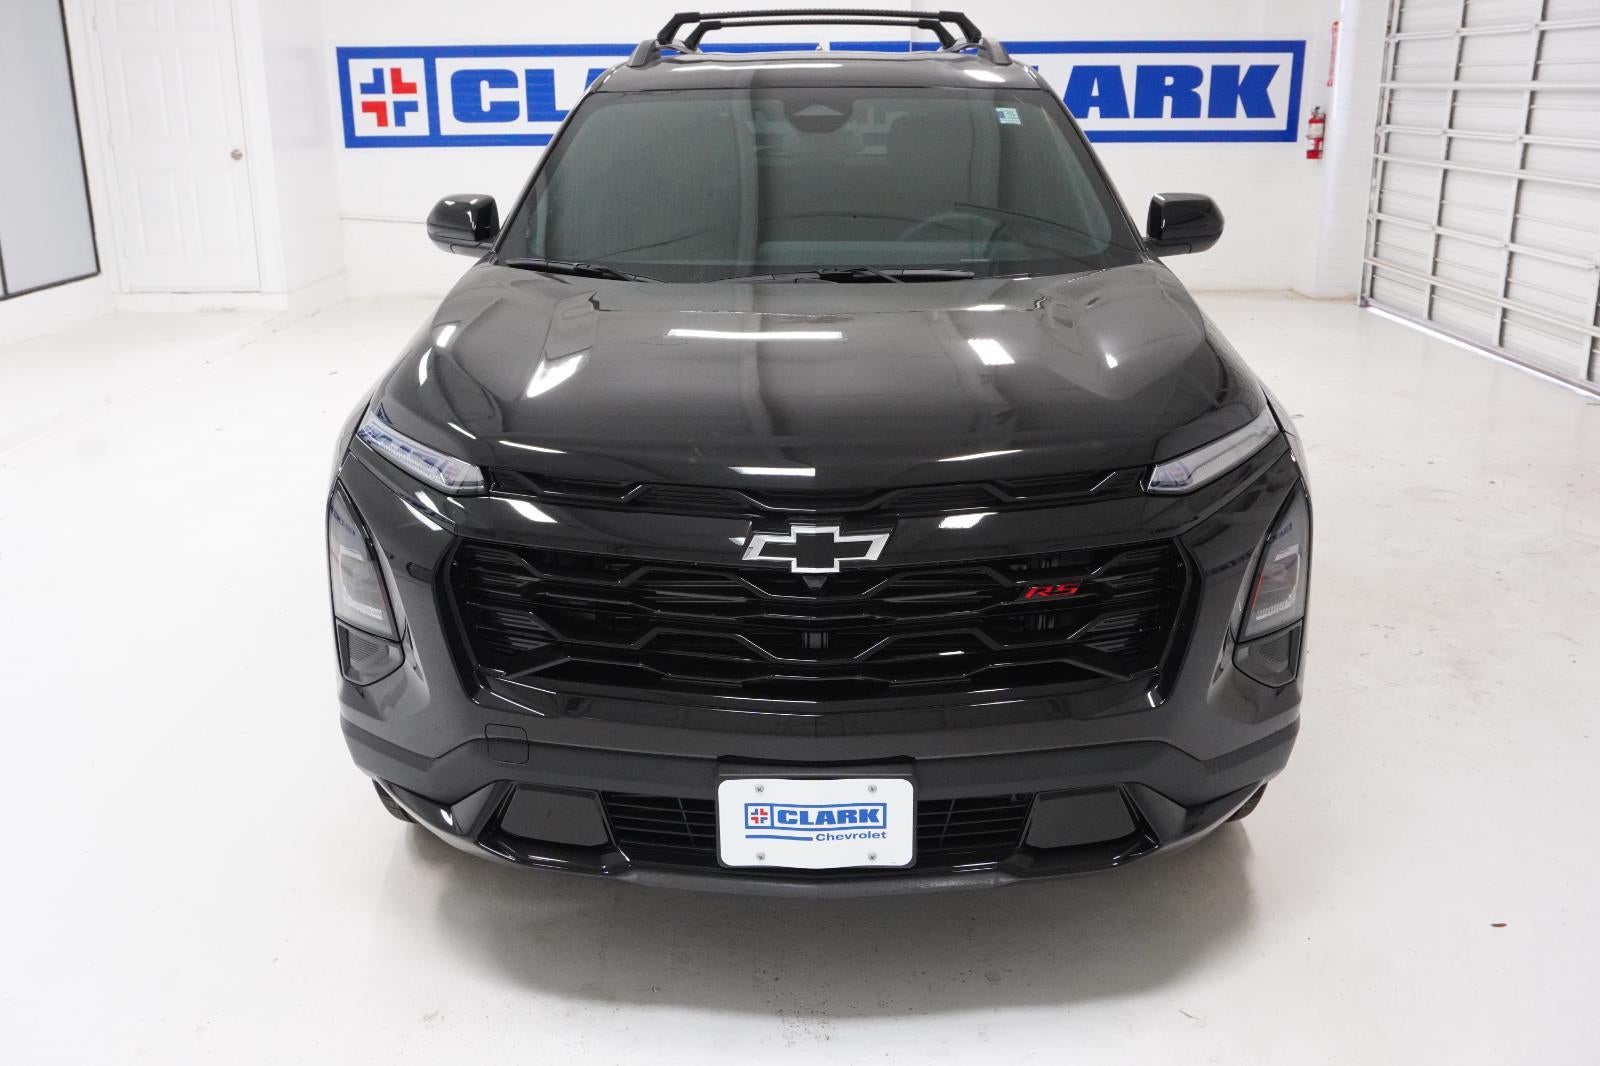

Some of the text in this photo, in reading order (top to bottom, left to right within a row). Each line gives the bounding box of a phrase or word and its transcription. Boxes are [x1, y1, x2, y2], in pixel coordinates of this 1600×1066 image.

[450, 67, 608, 123] CL
[1031, 65, 1279, 118] ARK
[1025, 584, 1079, 600] RS
[777, 809, 880, 825] CLARK
[816, 831, 887, 841] Chevrolet
